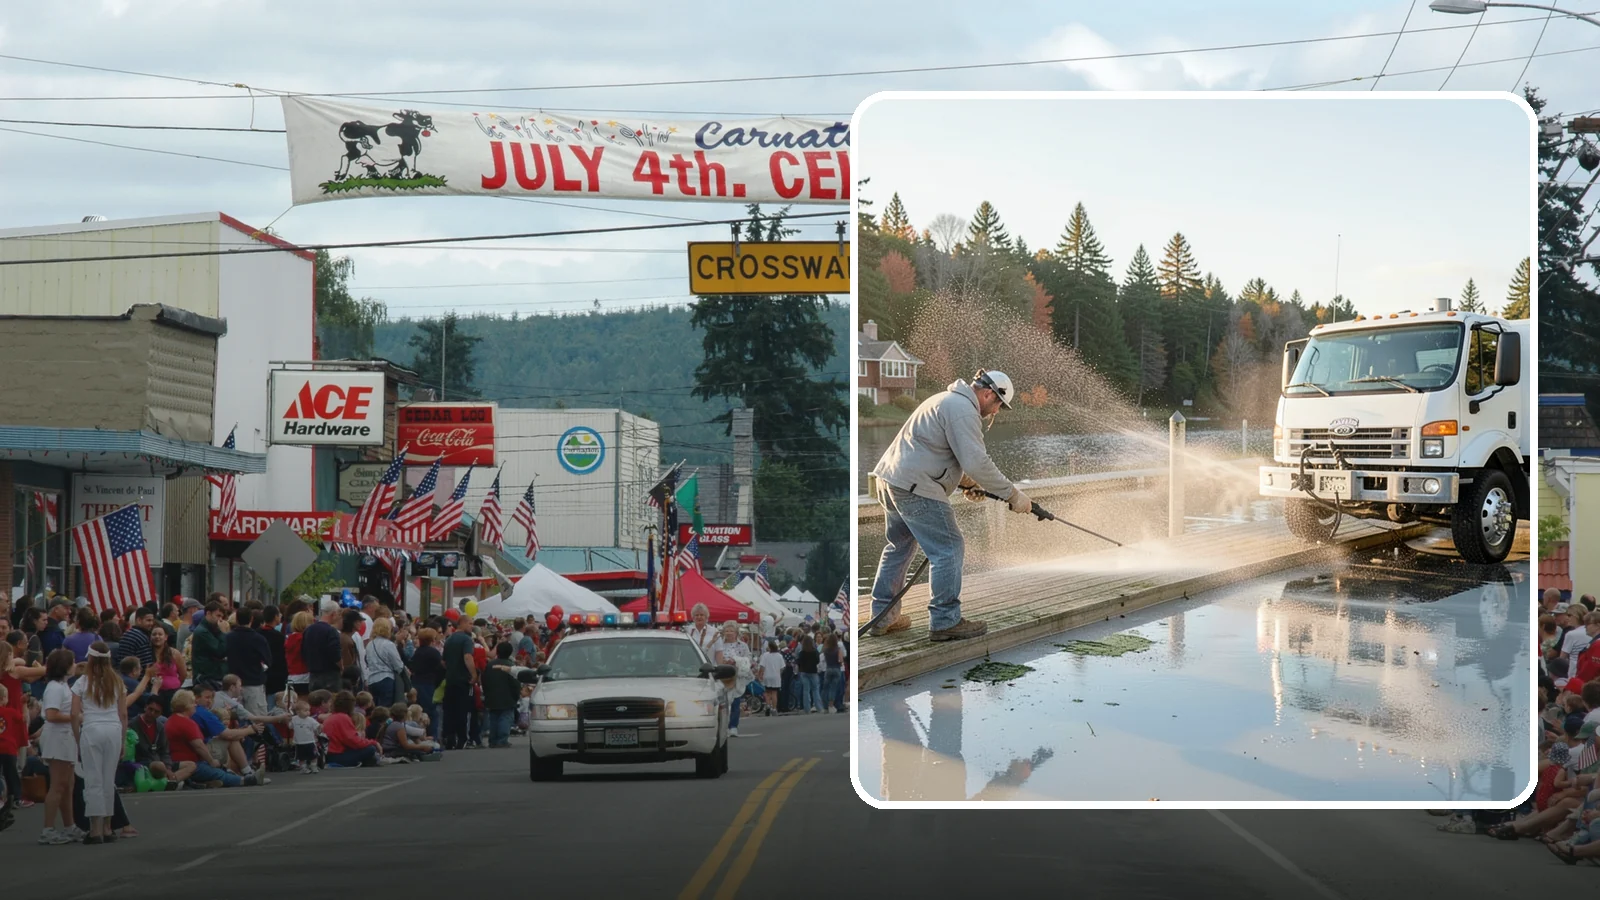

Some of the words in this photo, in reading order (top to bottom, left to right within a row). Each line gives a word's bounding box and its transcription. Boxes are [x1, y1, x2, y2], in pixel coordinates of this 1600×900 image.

[481, 140, 605, 193] JULY
[632, 150, 746, 198] 4th.
[696, 254, 850, 280] CROSSWA
[282, 380, 374, 420] ACE
[405, 409, 453, 422] CEDAR
[283, 421, 371, 437] Hardware
[416, 428, 477, 447] Coca-Cola
[83, 485, 94, 494] St.
[96, 485, 124, 495] Vincent
[126, 486, 136, 495] de
[137, 486, 155, 495] Paul
[212, 515, 331, 536] HARDARE
[688, 526, 742, 535] CRNATION
[699, 535, 730, 543] GLASS
